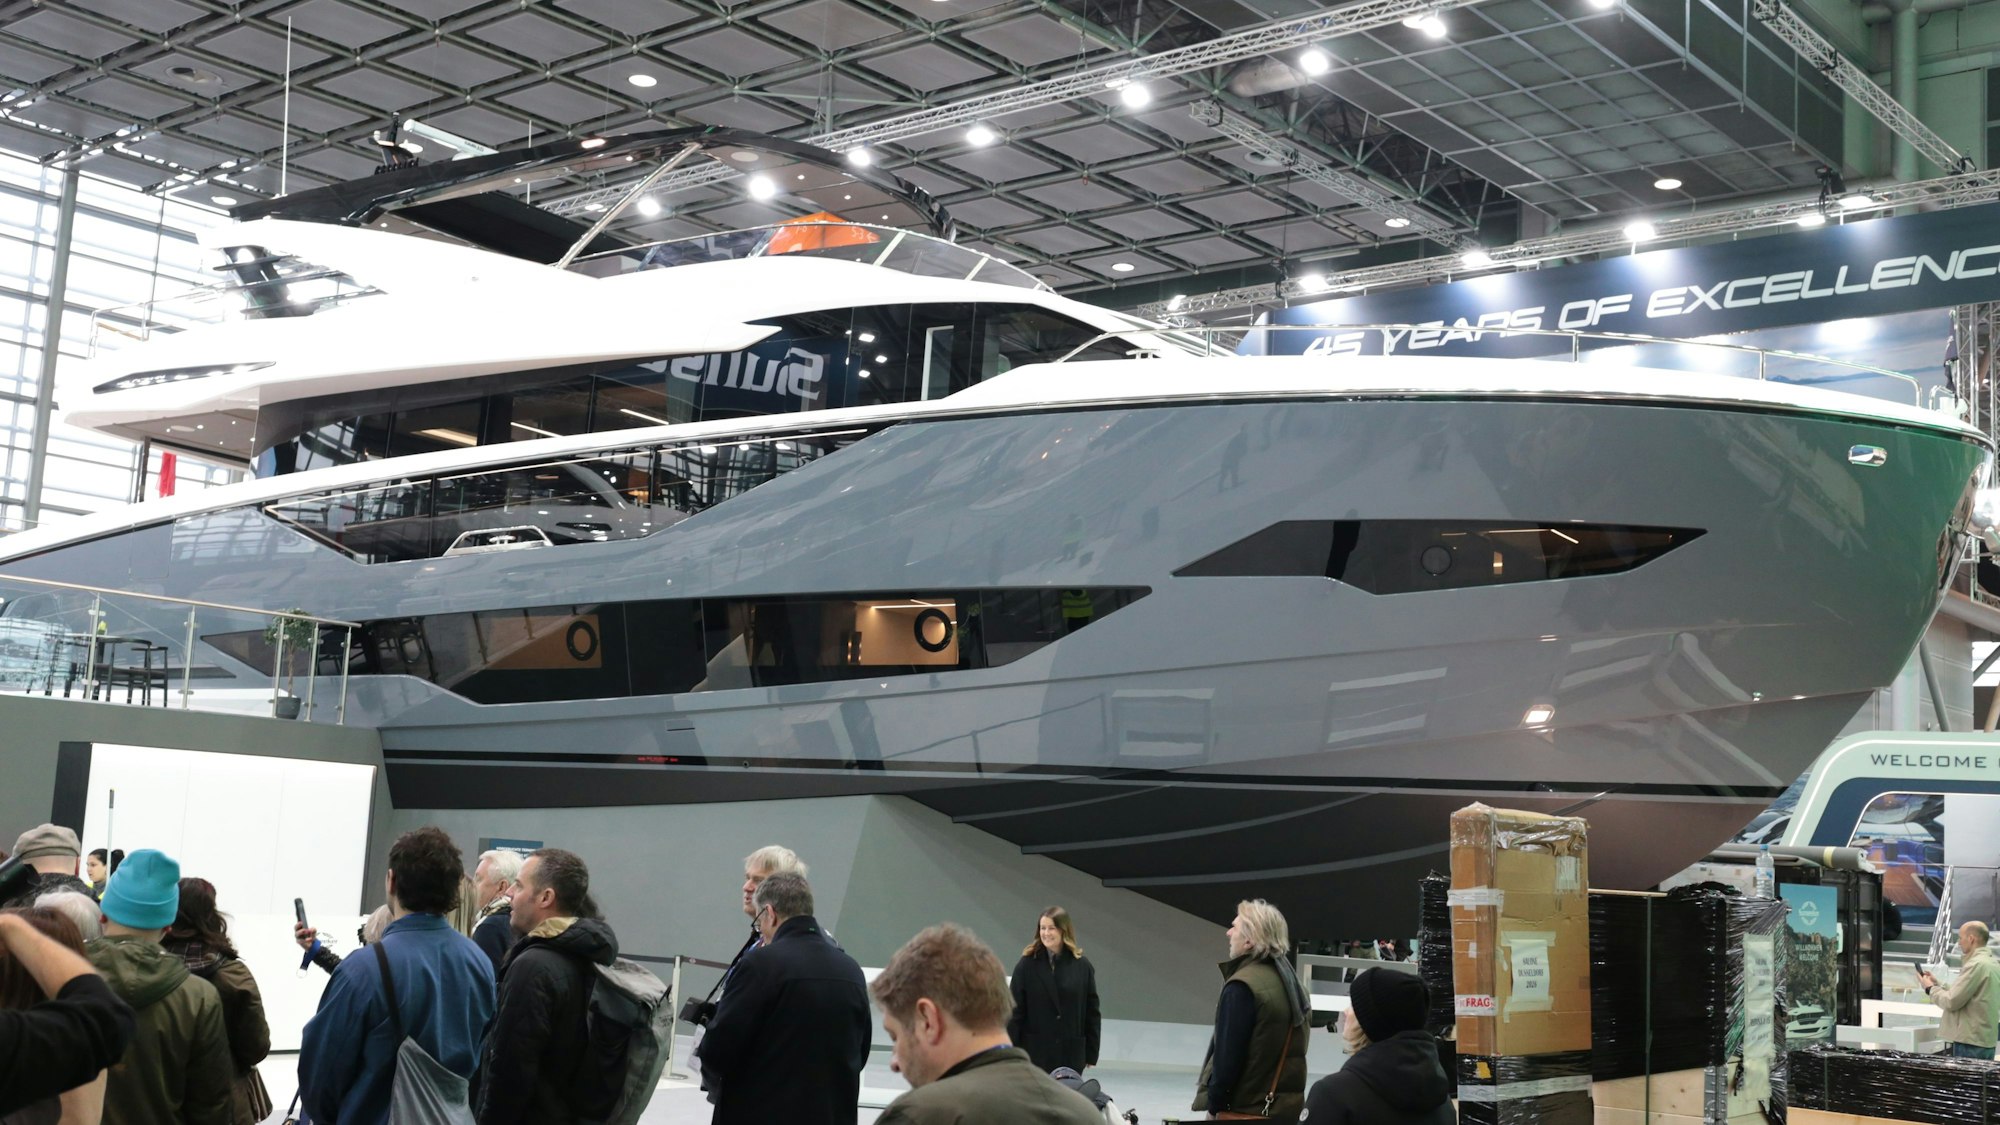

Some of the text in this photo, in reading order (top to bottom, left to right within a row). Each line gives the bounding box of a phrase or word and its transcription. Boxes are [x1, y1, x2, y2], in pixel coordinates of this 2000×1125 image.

[1303, 245, 2000, 356] 45 YEARS OF EXCELLENC
[1870, 754, 1987, 768] WELCOME
